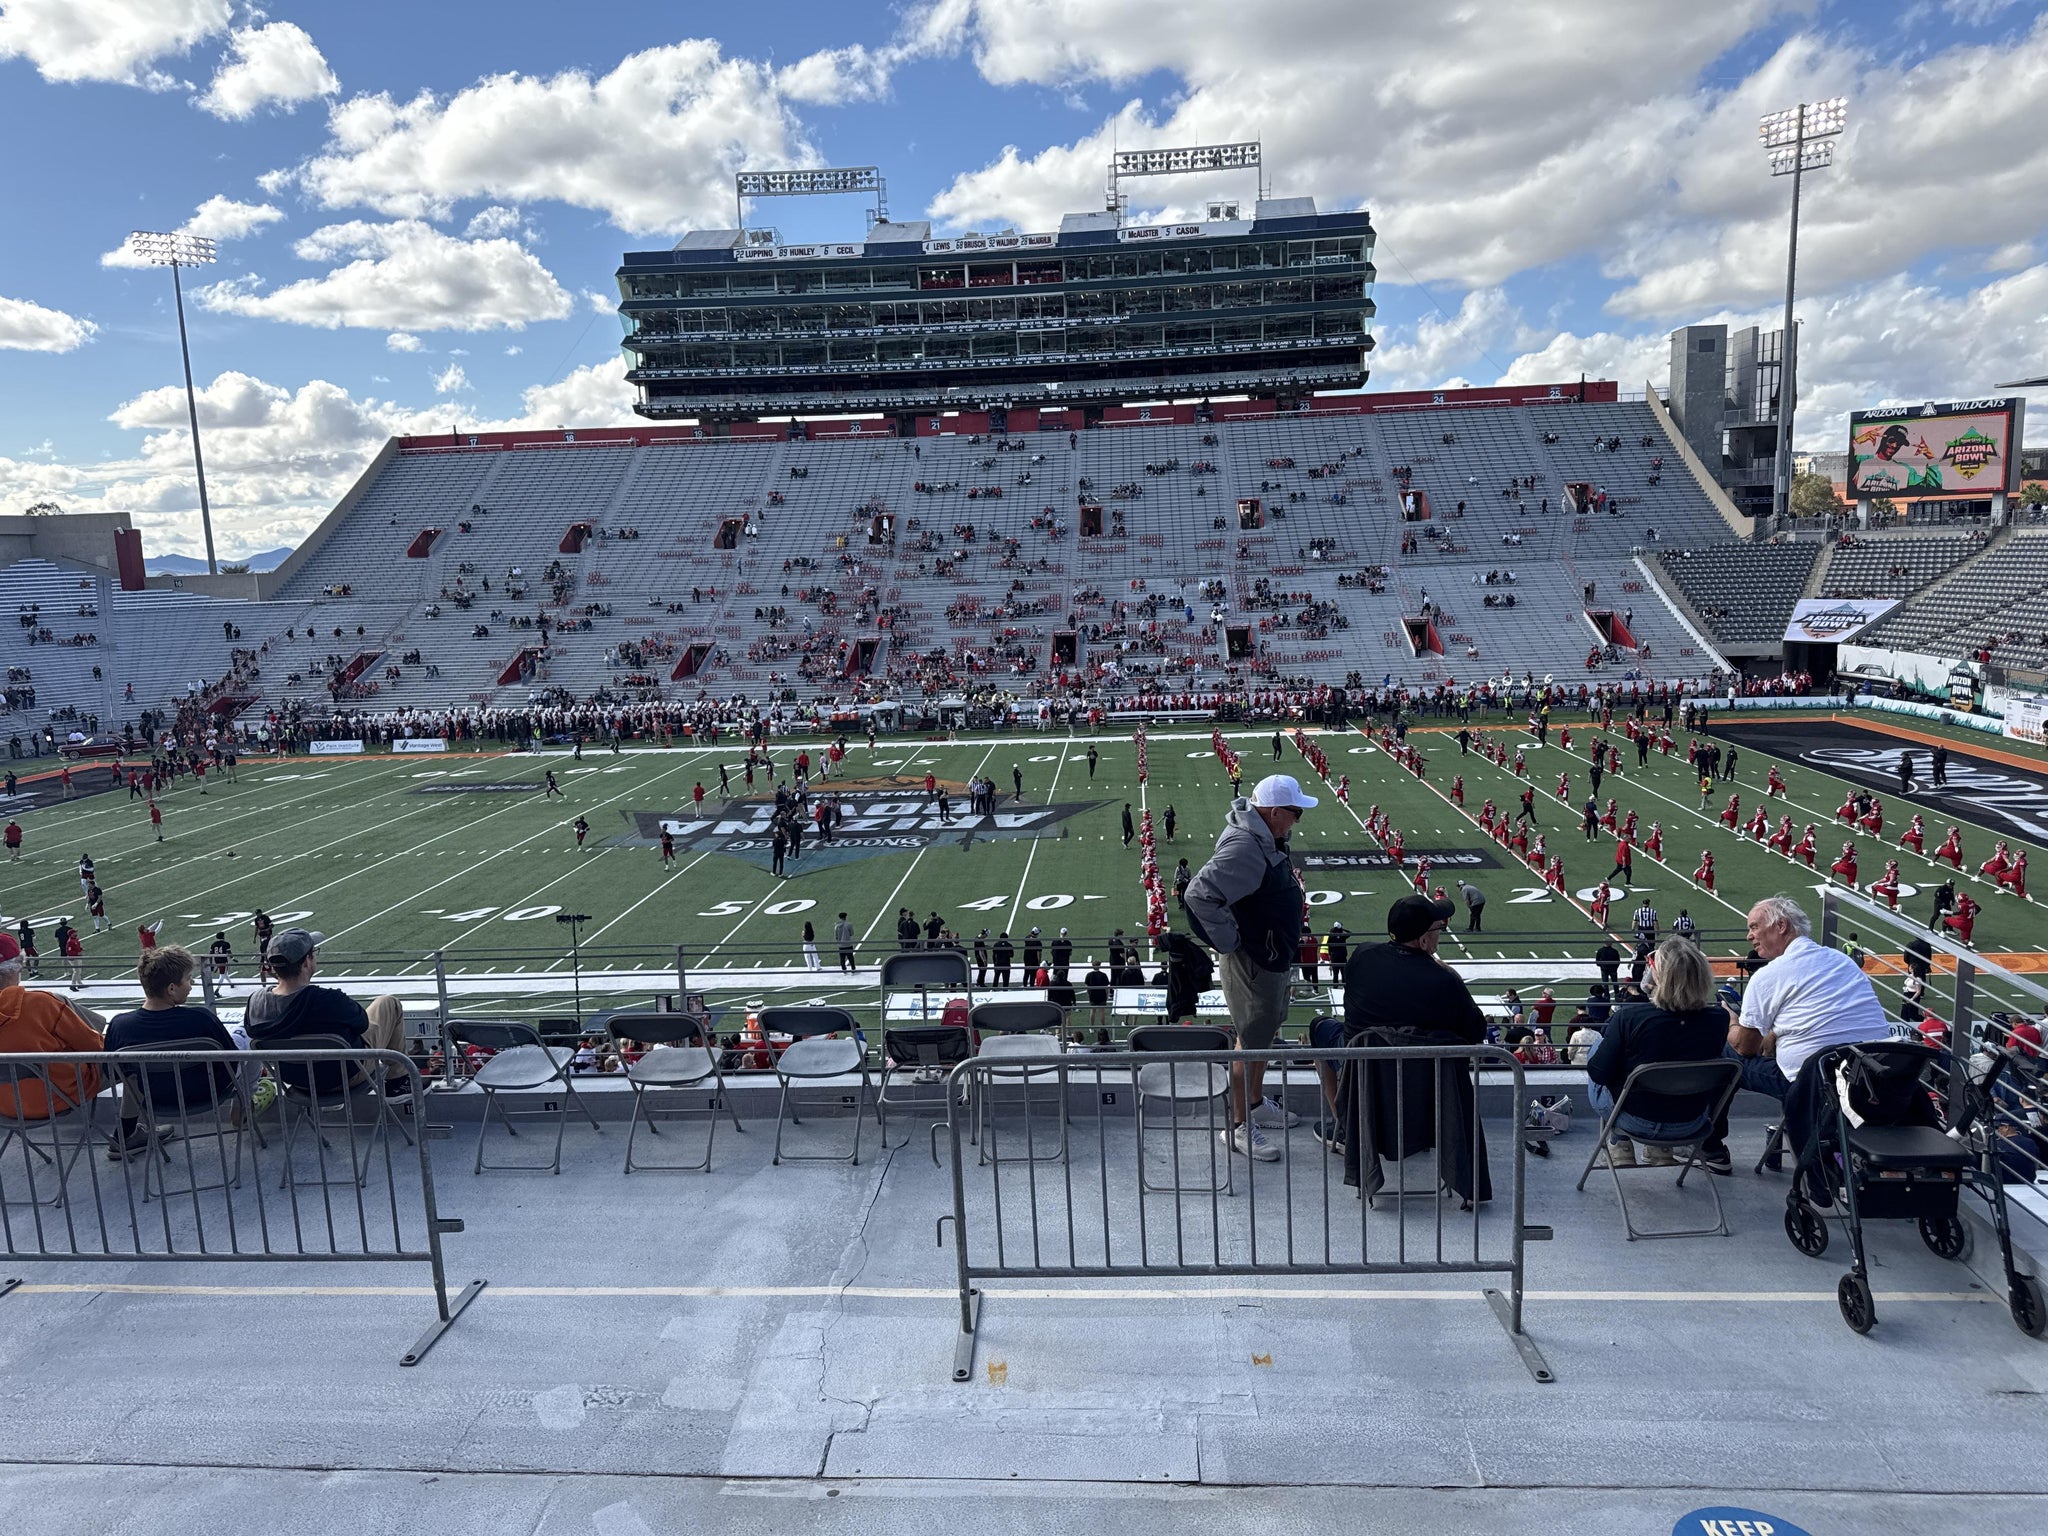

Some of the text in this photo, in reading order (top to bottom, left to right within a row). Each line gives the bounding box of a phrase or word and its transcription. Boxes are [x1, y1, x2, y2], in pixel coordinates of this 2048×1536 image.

[1128, 230, 1159, 238] McALISTER
[1166, 226, 1200, 236] 5 CASON
[925, 242, 950, 250] 4 LEWIS
[964, 240, 986, 248] BRUSCHI
[996, 238, 1019, 247] WALDROP
[736, 248, 773, 258] 22 LUPPINO
[790, 248, 815, 256] HUNLEY
[836, 246, 855, 255] CECIL
[1550, 390, 1561, 398] 25
[1434, 396, 1444, 404] 24
[1863, 398, 2007, 419] ARIZONA WILDCATS
[931, 422, 940, 430] 21
[1946, 444, 1994, 456] ARIZONA
[1955, 453, 1986, 462] BOWL
[1864, 478, 1897, 490] ARIZONA
[1948, 674, 1972, 686] ARIZON
[1952, 686, 1974, 697] BOWL
[697, 898, 818, 916] 50
[957, 894, 1075, 911] 40
[439, 904, 563, 922] 40
[1106, 1094, 1112, 1103] 5
[1546, 1098, 1552, 1106] 2
